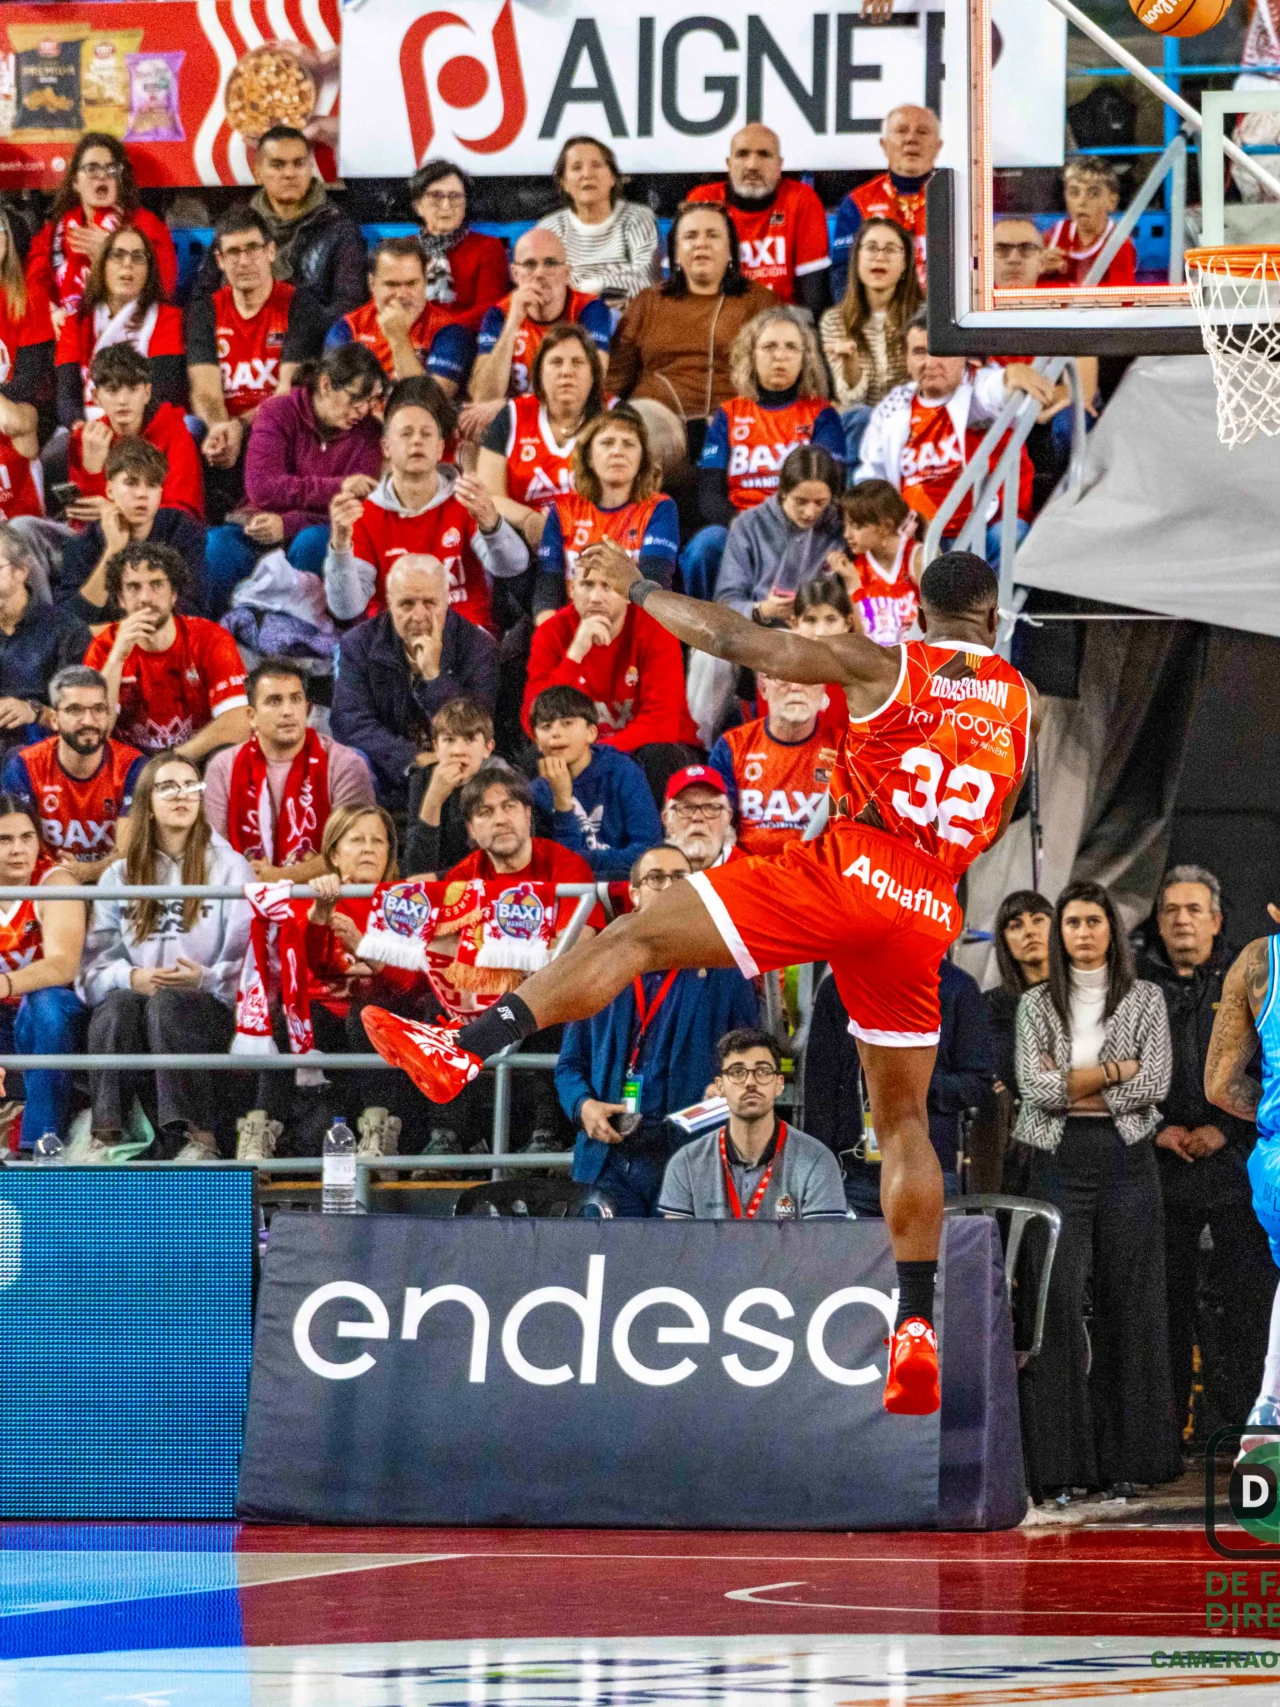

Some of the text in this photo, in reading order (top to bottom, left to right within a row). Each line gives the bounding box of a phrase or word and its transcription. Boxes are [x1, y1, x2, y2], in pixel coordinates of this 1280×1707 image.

[738, 236, 786, 267] AXI
[892, 747, 995, 849] 32
[386, 896, 428, 919] BAXI
[499, 903, 542, 920] BAXI
[293, 1254, 900, 1386] endesa
